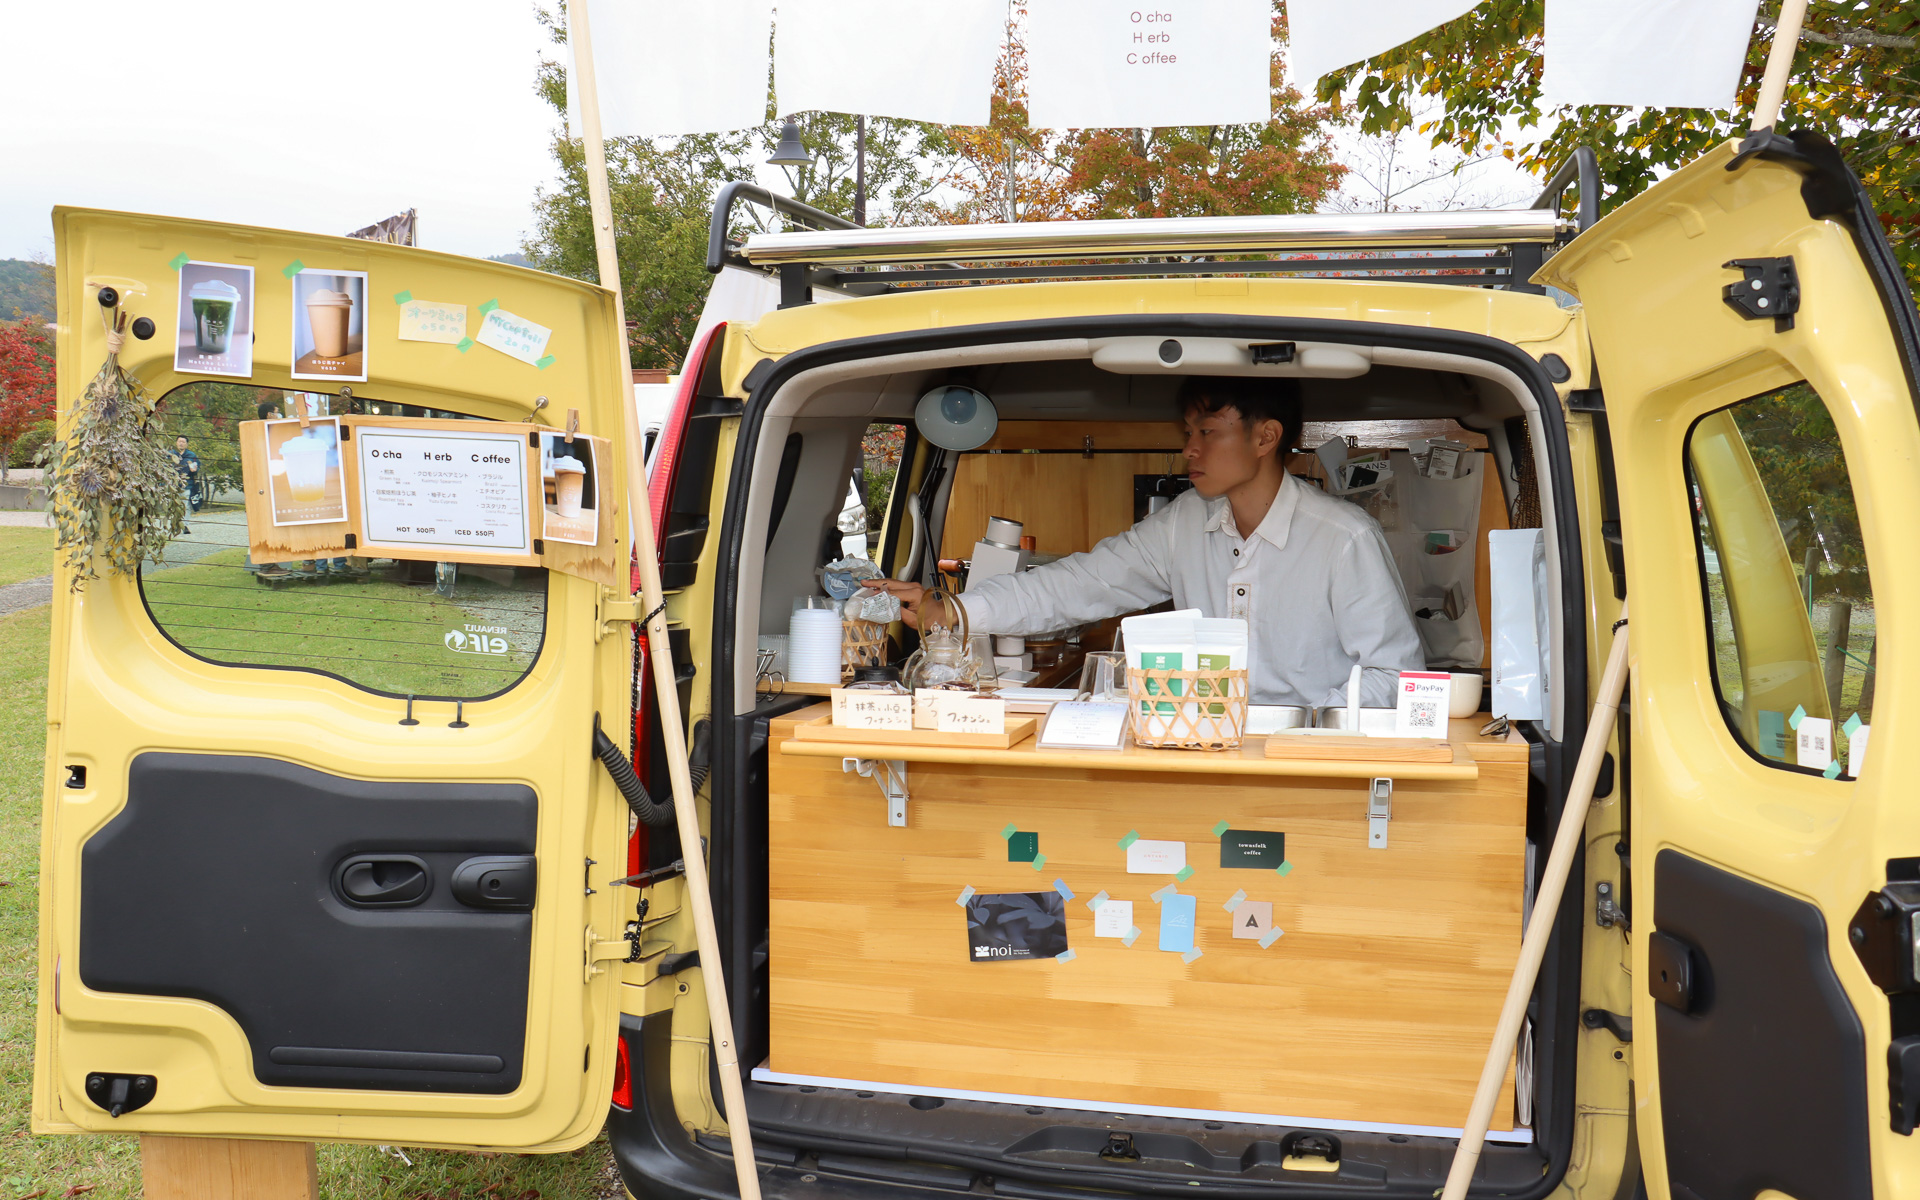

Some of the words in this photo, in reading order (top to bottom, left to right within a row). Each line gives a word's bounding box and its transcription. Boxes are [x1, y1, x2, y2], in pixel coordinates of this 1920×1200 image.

[1130, 11, 1142, 23] O
[1146, 10, 1172, 23] cha
[1133, 32, 1143, 43] H
[1147, 31, 1170, 43] erb
[1126, 52, 1137, 65] C
[1142, 51, 1177, 64] offee
[371, 449, 380, 458] O
[382, 450, 402, 459] cha
[423, 451, 432, 460] H
[434, 452, 453, 462] erb
[470, 453, 480, 462] C
[482, 454, 511, 464] offee
[416, 527, 436, 535] 500円
[475, 530, 495, 538] 550円
[1416, 684, 1445, 693] PayPay
[1245, 913, 1259, 928] A
[990, 944, 1012, 957] noi
